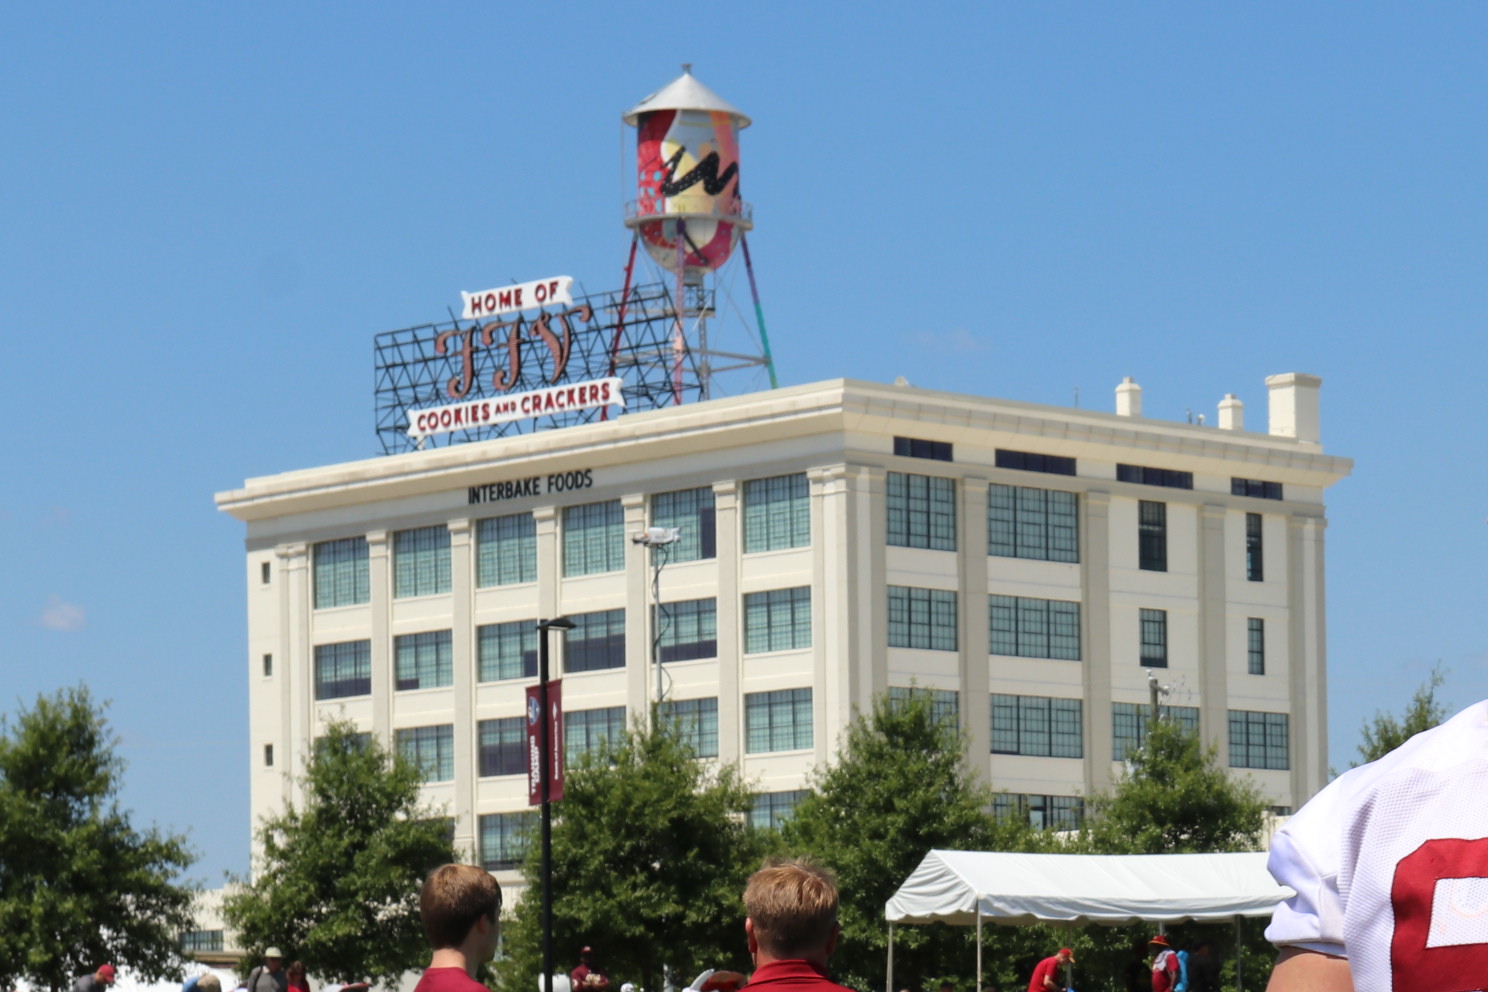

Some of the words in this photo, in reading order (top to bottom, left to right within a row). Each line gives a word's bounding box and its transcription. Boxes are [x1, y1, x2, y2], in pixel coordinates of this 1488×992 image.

[471, 288, 523, 314] HOME
[535, 281, 559, 301] OF
[417, 403, 490, 431] COOKIES
[495, 400, 516, 415] AND
[521, 382, 611, 414] CRACKERS
[468, 476, 541, 504] INTERBAKE
[547, 469, 593, 493] FOODS
